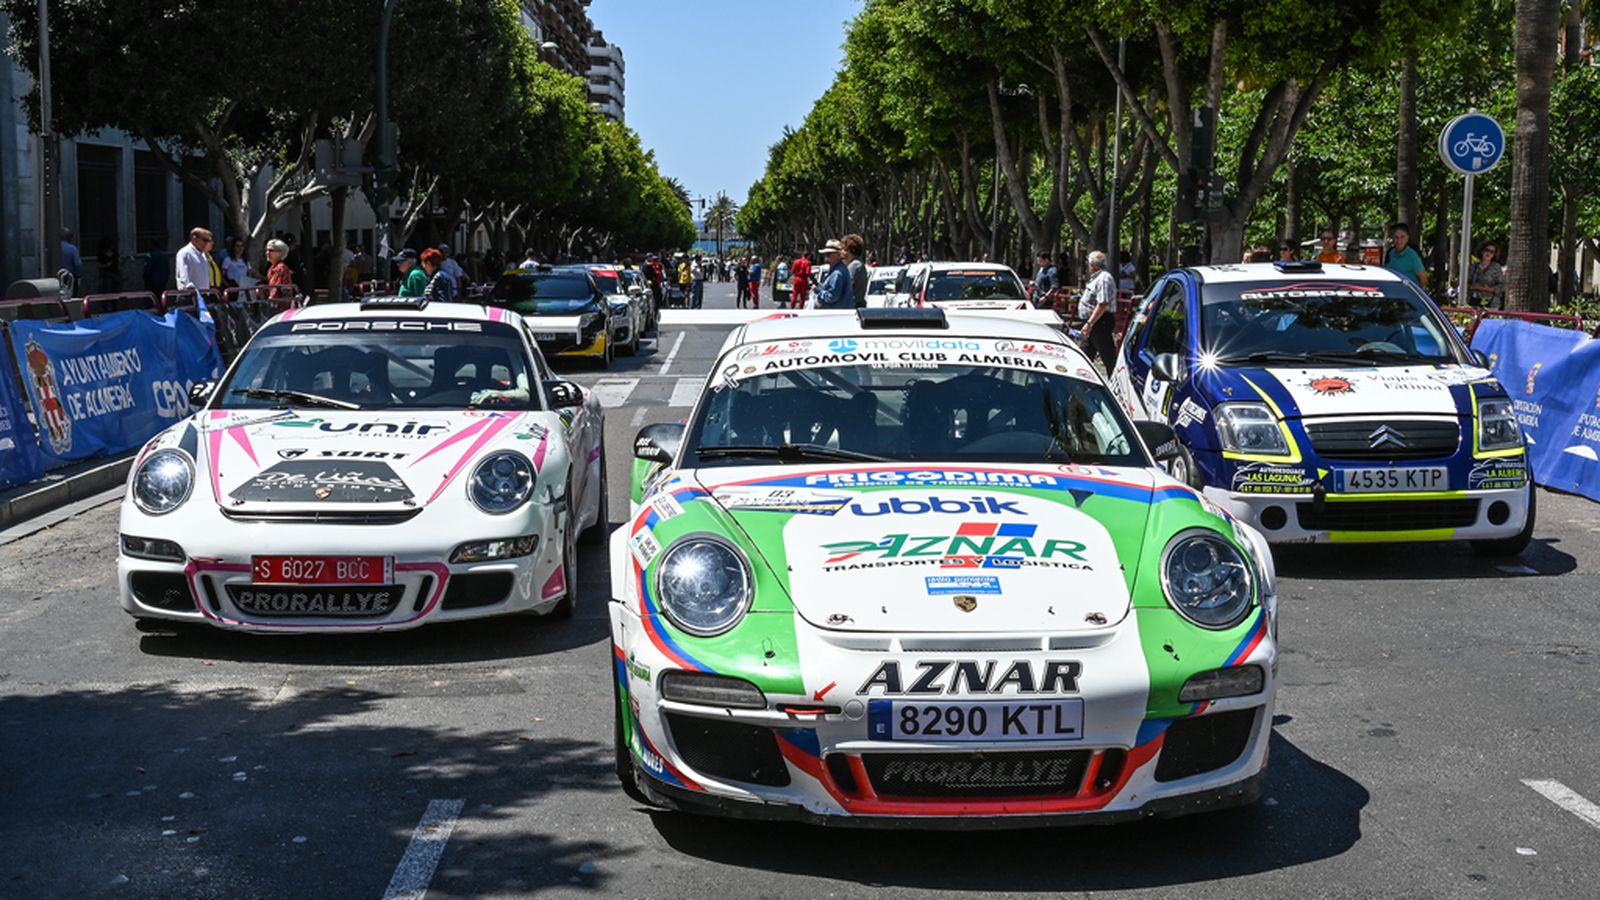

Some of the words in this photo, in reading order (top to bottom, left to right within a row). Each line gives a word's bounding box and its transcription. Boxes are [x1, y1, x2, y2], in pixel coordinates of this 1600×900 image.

[1240, 290, 1385, 300] AUTOSPEED
[291, 321, 482, 332] PORSCHE
[864, 339, 980, 351] movildata
[60, 348, 142, 386] AYUNTAMIENTO
[764, 352, 889, 371] AUTOMOVIL
[898, 352, 947, 361] CLUB
[958, 354, 1047, 370] ALMERIA
[67, 392, 86, 421] DE
[806, 471, 1057, 486] FRIGODIMA
[1247, 472, 1263, 482] LAS
[1263, 474, 1303, 484] LAGUNAS
[1349, 470, 1399, 489] 4535
[1406, 469, 1442, 488] KTP
[851, 496, 1029, 517] ubbik
[819, 533, 1088, 562] AZNAR
[260, 560, 271, 579] S
[281, 560, 326, 580] 6027
[337, 561, 370, 579] BCC
[822, 558, 965, 572] TRANSPORTES
[992, 558, 1094, 572] LOGISTICA
[239, 591, 390, 612] PRORALLYE
[856, 660, 1084, 695] AZNAR
[900, 705, 988, 737] 8290
[1002, 704, 1076, 736] KTL
[882, 758, 1073, 786] PRORALLYE
